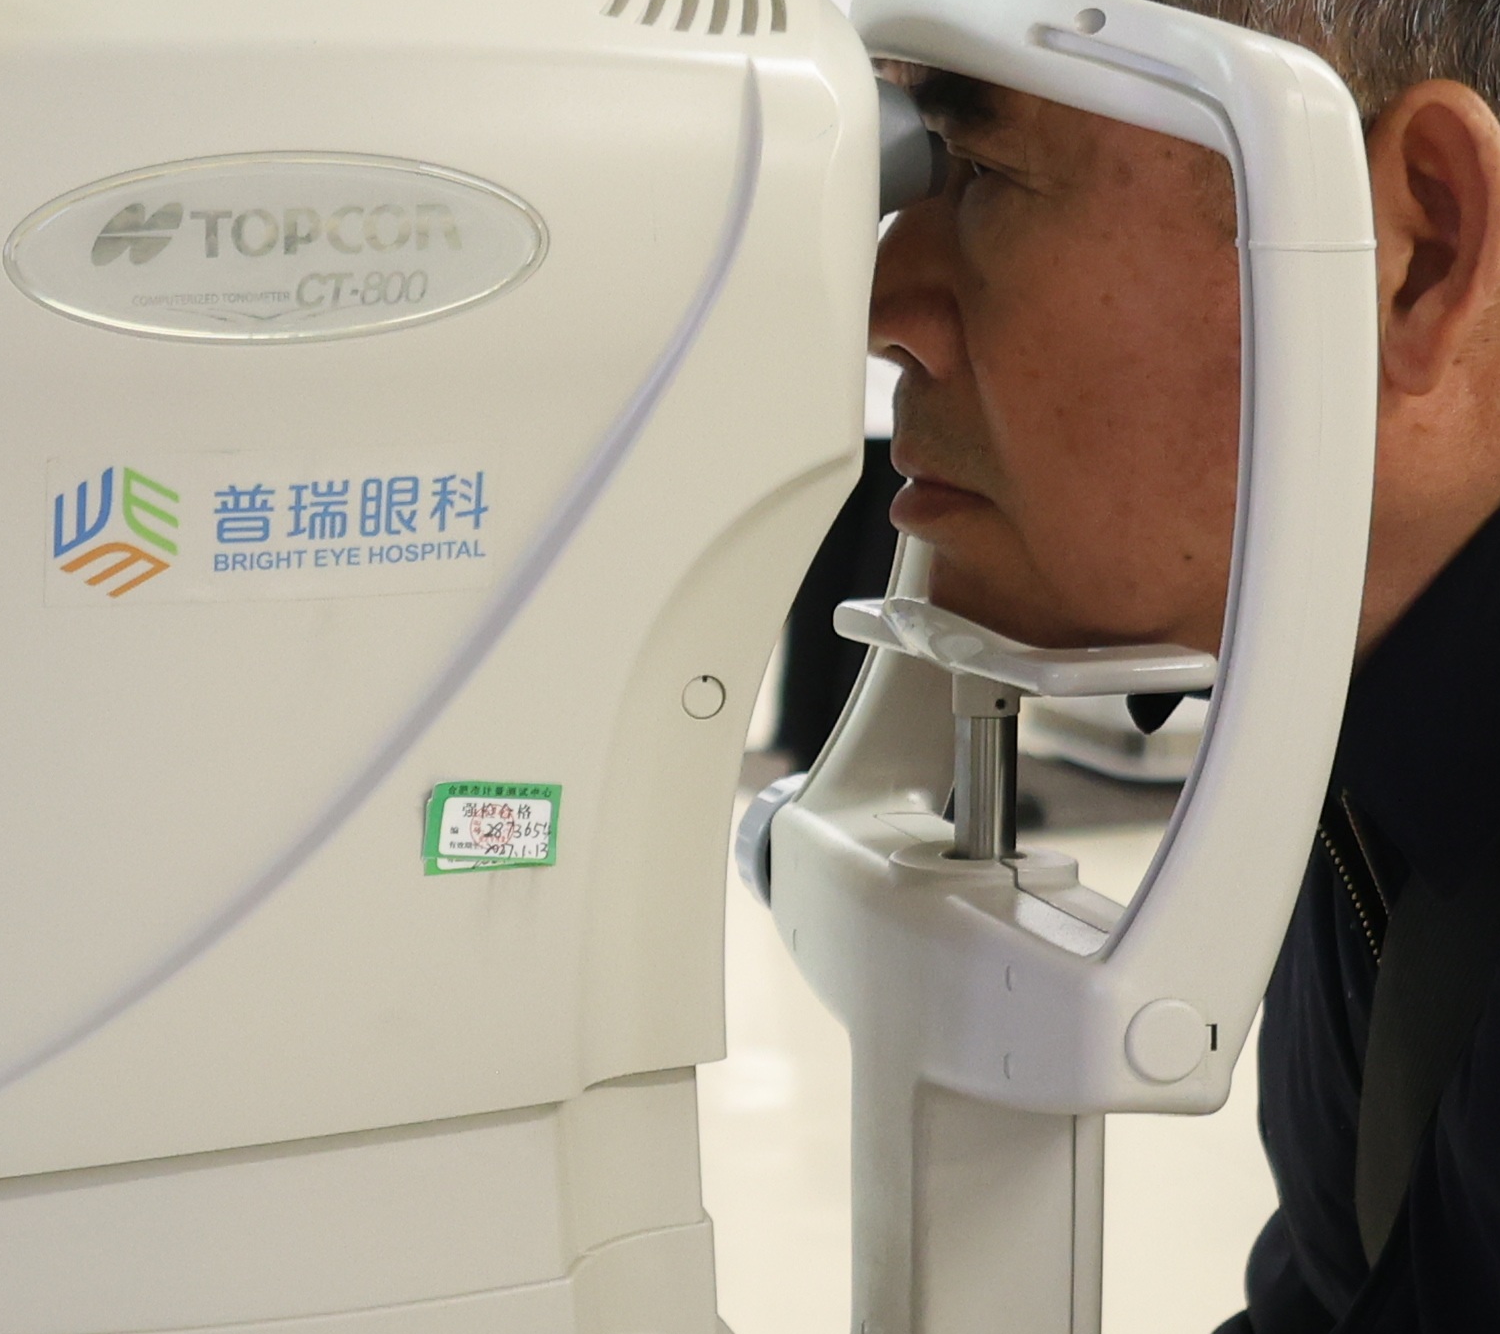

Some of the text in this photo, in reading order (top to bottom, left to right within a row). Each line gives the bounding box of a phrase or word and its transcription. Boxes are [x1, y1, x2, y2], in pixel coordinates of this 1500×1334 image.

[131, 269, 430, 310] COMPUTERIZED TONOMETER CT-800
[213, 471, 489, 544] 普瑞眼科
[213, 539, 486, 572] BRIGHT EYE HOSPITAL
